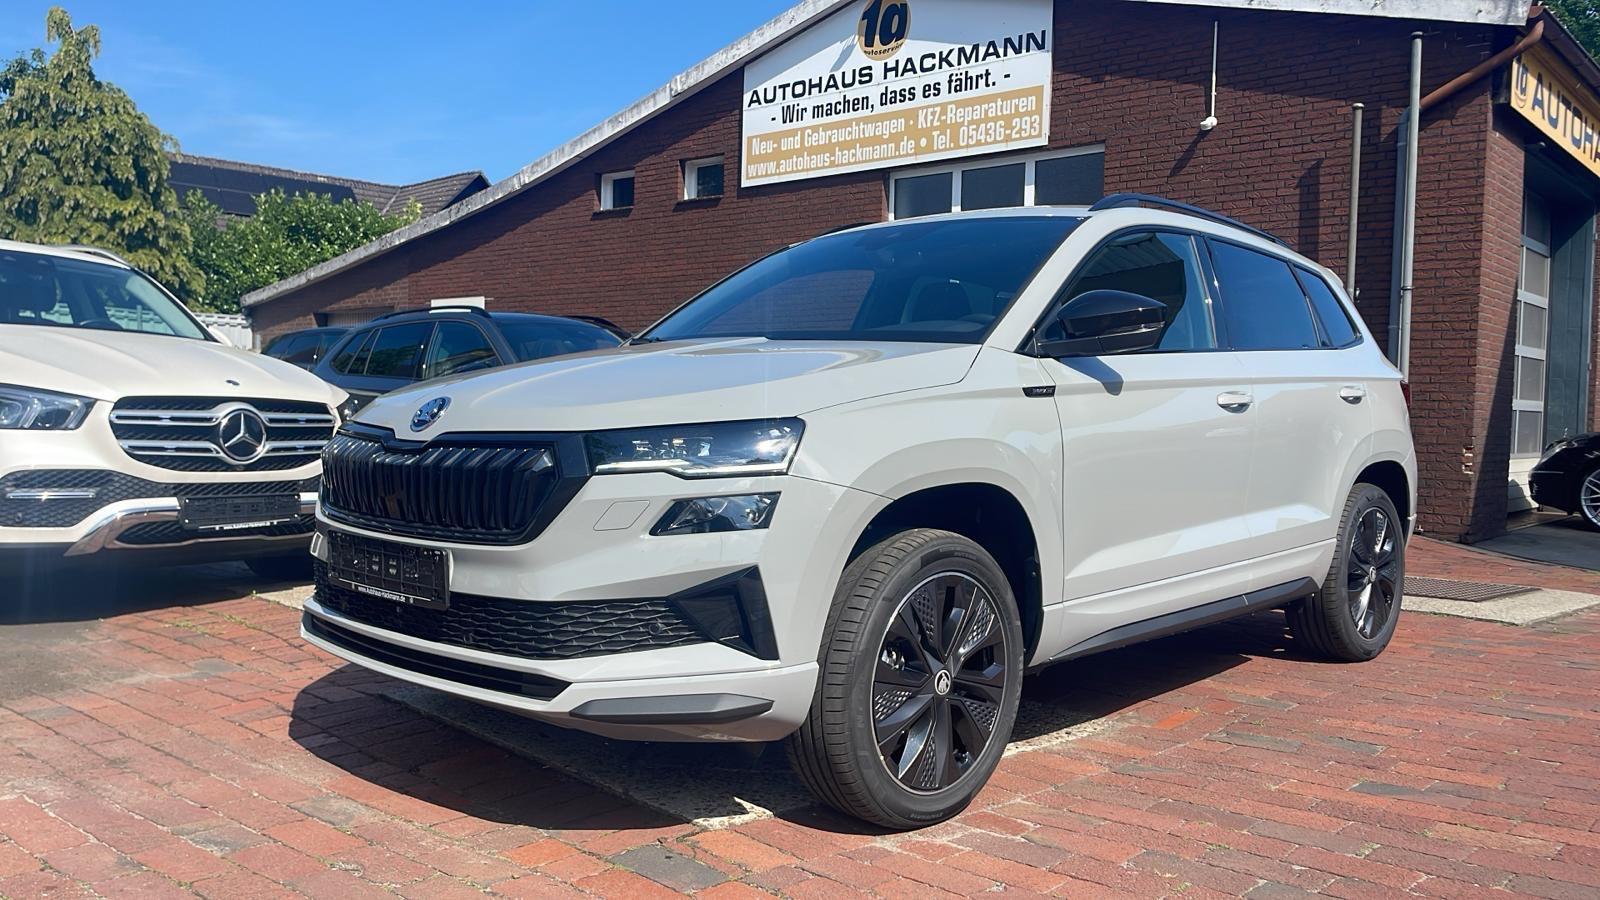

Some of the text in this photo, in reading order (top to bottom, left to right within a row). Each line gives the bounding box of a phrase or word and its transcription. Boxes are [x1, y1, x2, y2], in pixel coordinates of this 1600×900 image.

[747, 29, 1047, 108] AUTOHAUS HACKMANN
[781, 103, 807, 124] Wir
[812, 94, 875, 119] machen,
[879, 86, 916, 107] dass
[922, 81, 941, 99] es
[947, 69, 996, 94] fährt.
[747, 115, 1040, 177] www.autohaus-hackmann.de Tel. 05436-293
[752, 95, 1036, 156] Neu- und Gebrauchtwagen KFZ-Reparaturen
